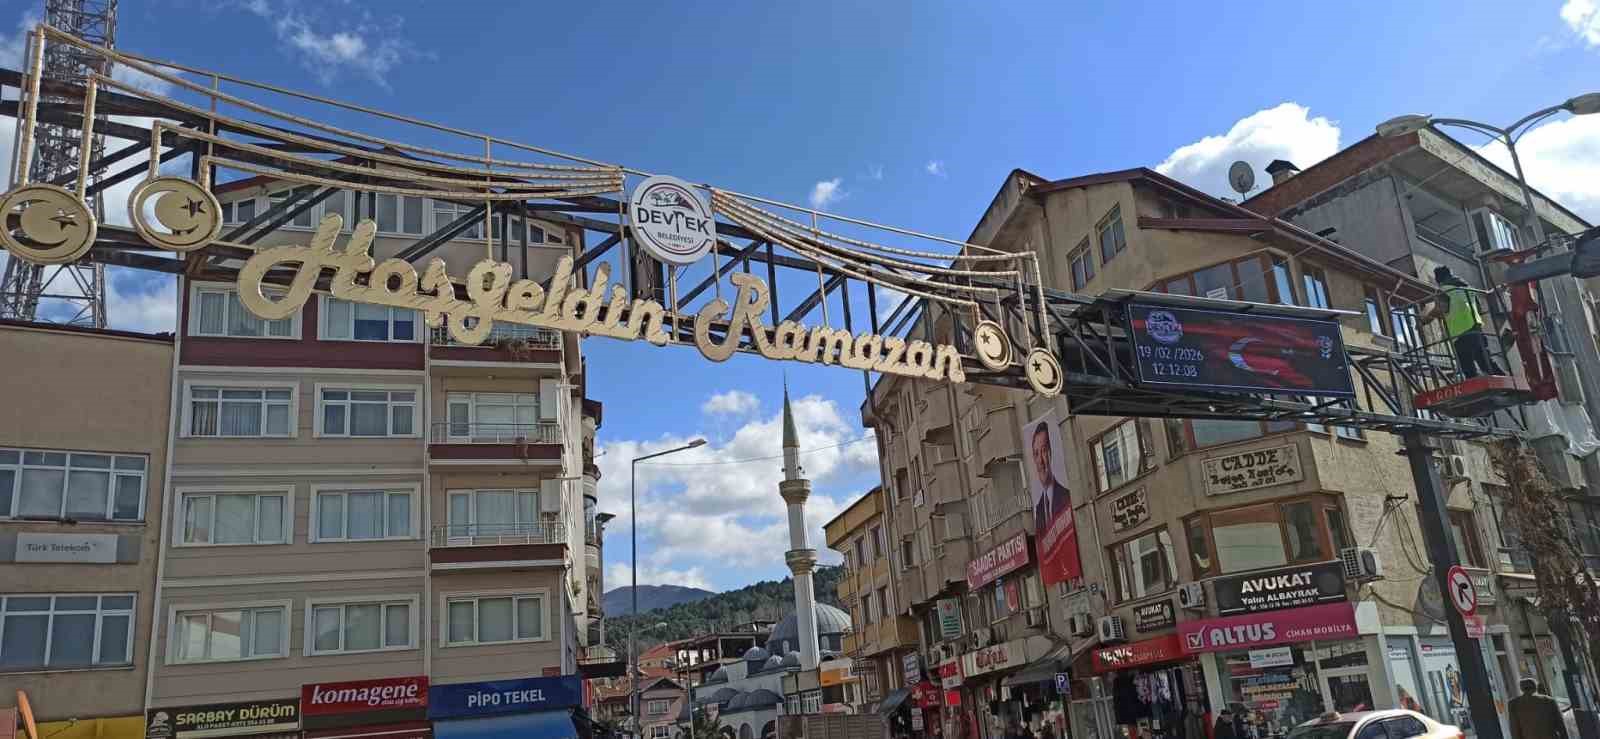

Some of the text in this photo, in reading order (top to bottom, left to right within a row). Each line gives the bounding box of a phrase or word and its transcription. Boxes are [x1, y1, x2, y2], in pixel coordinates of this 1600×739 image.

[237, 212, 966, 384] Hoşgeldin Ramazan
[1221, 449, 1279, 471] CADDE
[25, 543, 91, 552] Türk Telekom
[971, 549, 997, 576] SAADET
[997, 534, 1025, 562] PARTİSİ
[1241, 572, 1313, 594] AVUKAT
[1267, 588, 1319, 602] ALBAYRAK
[1210, 623, 1352, 646] ALTUS CİHAN MOBİLYA
[1057, 674, 1065, 688] P
[312, 684, 418, 706] komagene
[467, 689, 546, 708] PİPO TEKEL
[175, 710, 235, 725] SARBAY
[239, 703, 295, 720] DÜRÜM
